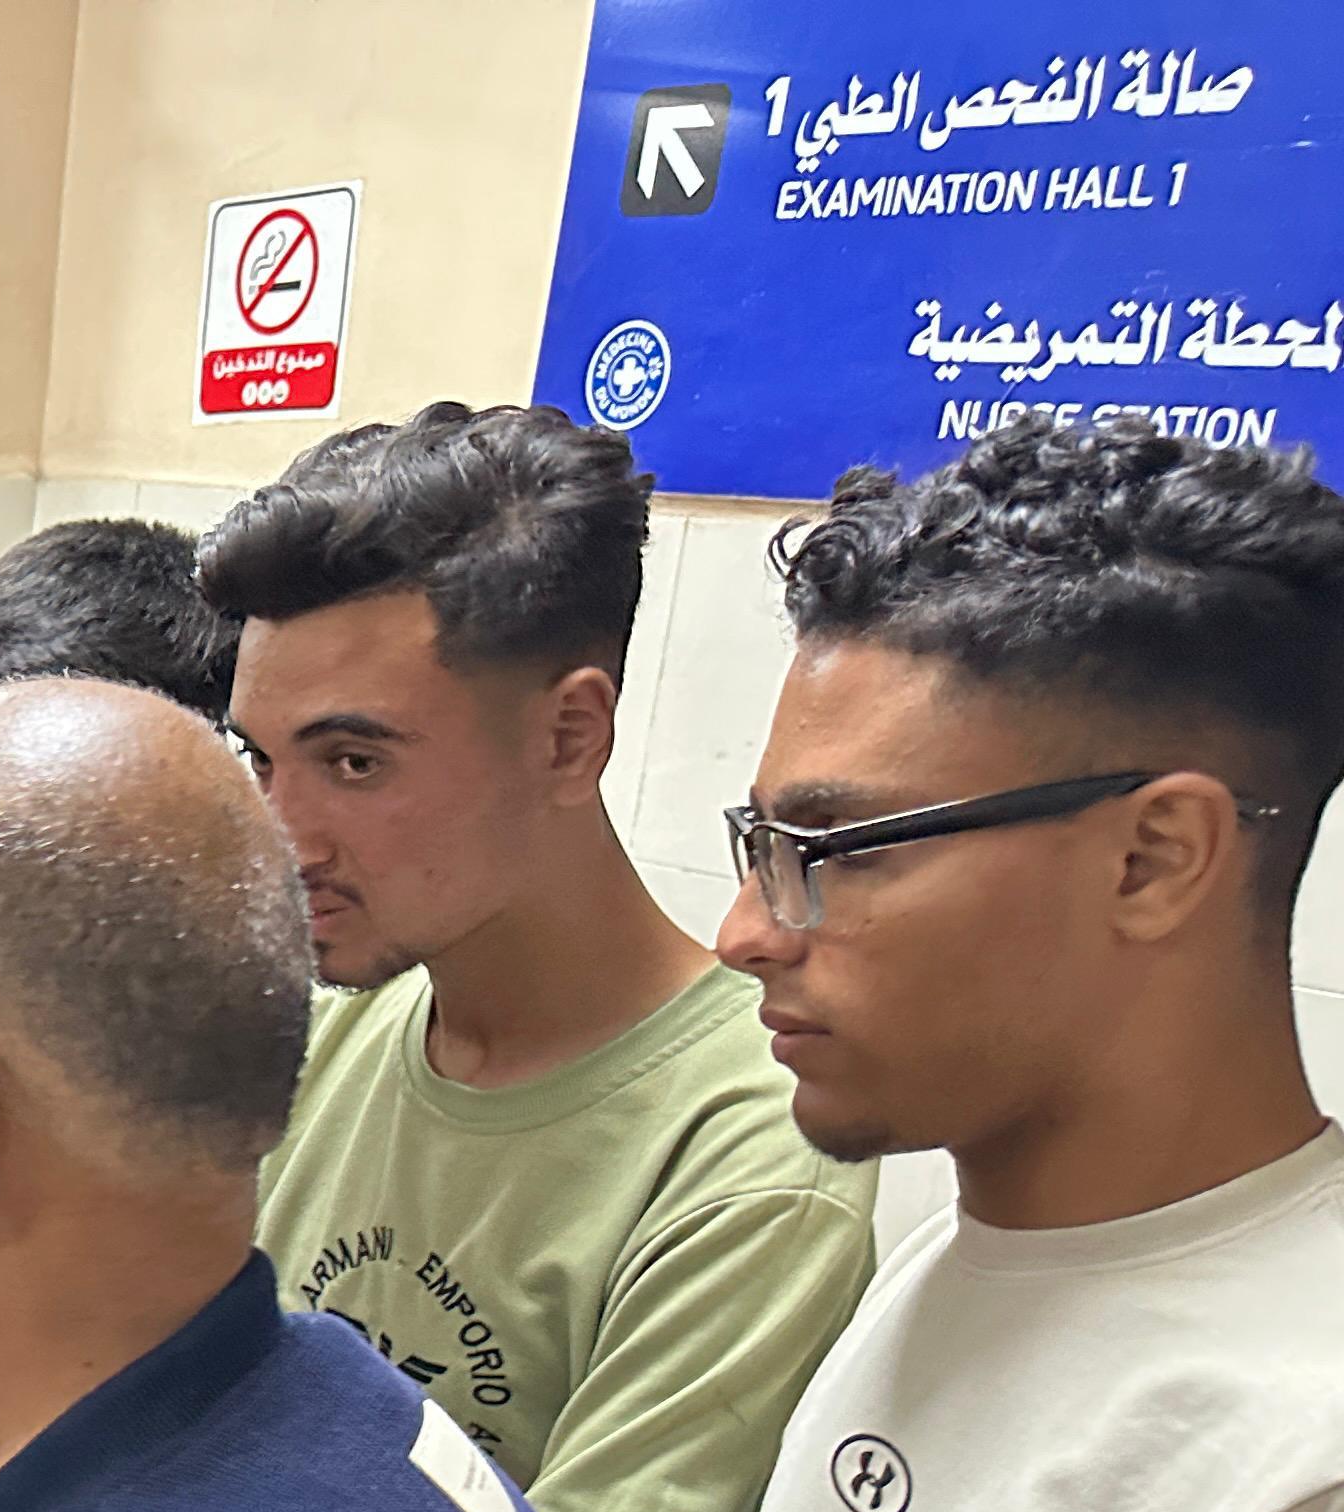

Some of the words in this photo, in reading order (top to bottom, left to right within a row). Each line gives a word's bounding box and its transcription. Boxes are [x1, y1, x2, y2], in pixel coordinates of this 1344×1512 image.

[764, 75, 792, 137] 1
[794, 69, 922, 174] الطبي
[918, 54, 1107, 151] الفحص
[1113, 47, 1254, 118] صالة
[775, 168, 1039, 221] EXAMINATION
[1043, 164, 1155, 212] HALL
[1168, 162, 1189, 208] 1
[275, 347, 327, 375] ممنوع
[908, 298, 1174, 384] التمريضية
[1179, 297, 1344, 375] لمحطة
[300, 1225, 394, 1312] ARMANI
[414, 1251, 512, 1407] EMPORIO
